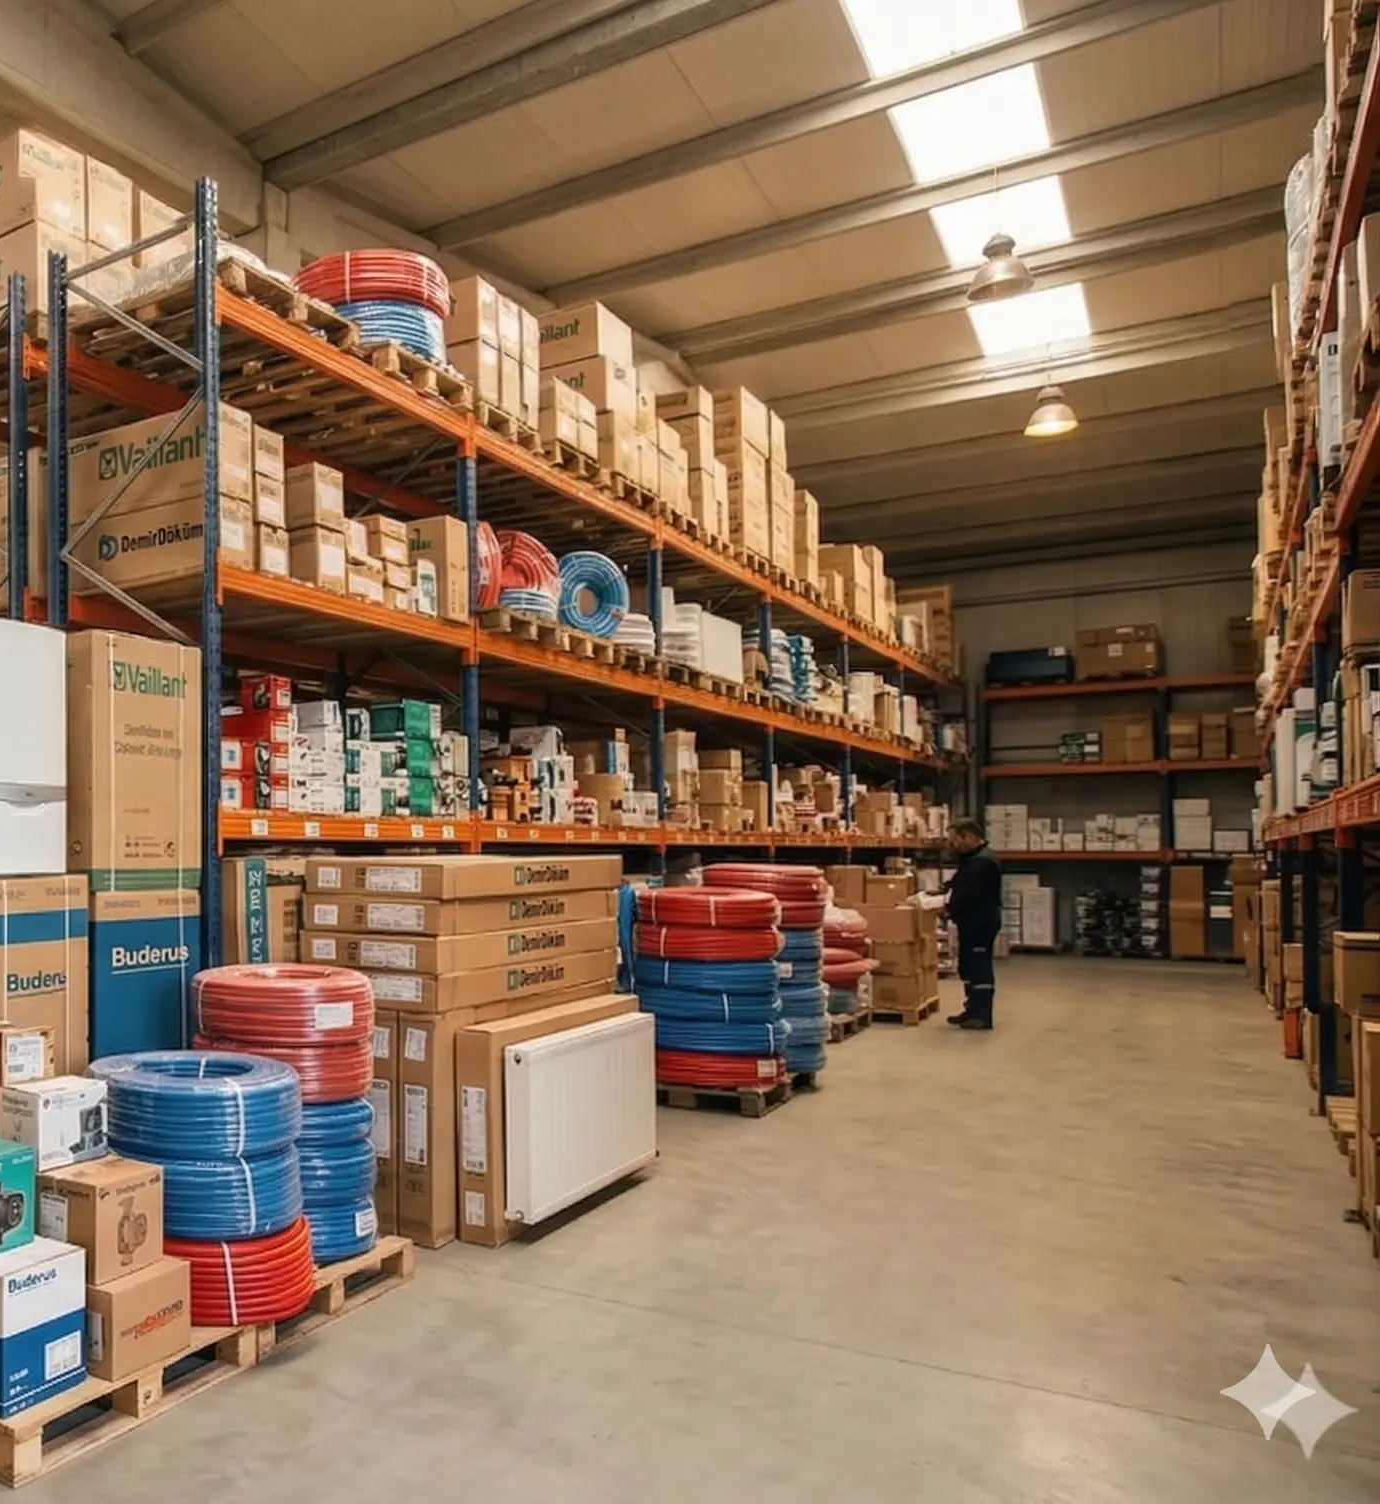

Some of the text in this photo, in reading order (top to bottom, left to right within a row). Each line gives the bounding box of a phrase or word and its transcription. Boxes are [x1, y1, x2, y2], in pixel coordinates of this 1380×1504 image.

[540, 318, 581, 343] illant
[119, 426, 205, 475] Vaillant
[128, 663, 188, 699] Vaillant
[111, 943, 189, 969] Buderus
[8, 1268, 57, 1294] Buderus
